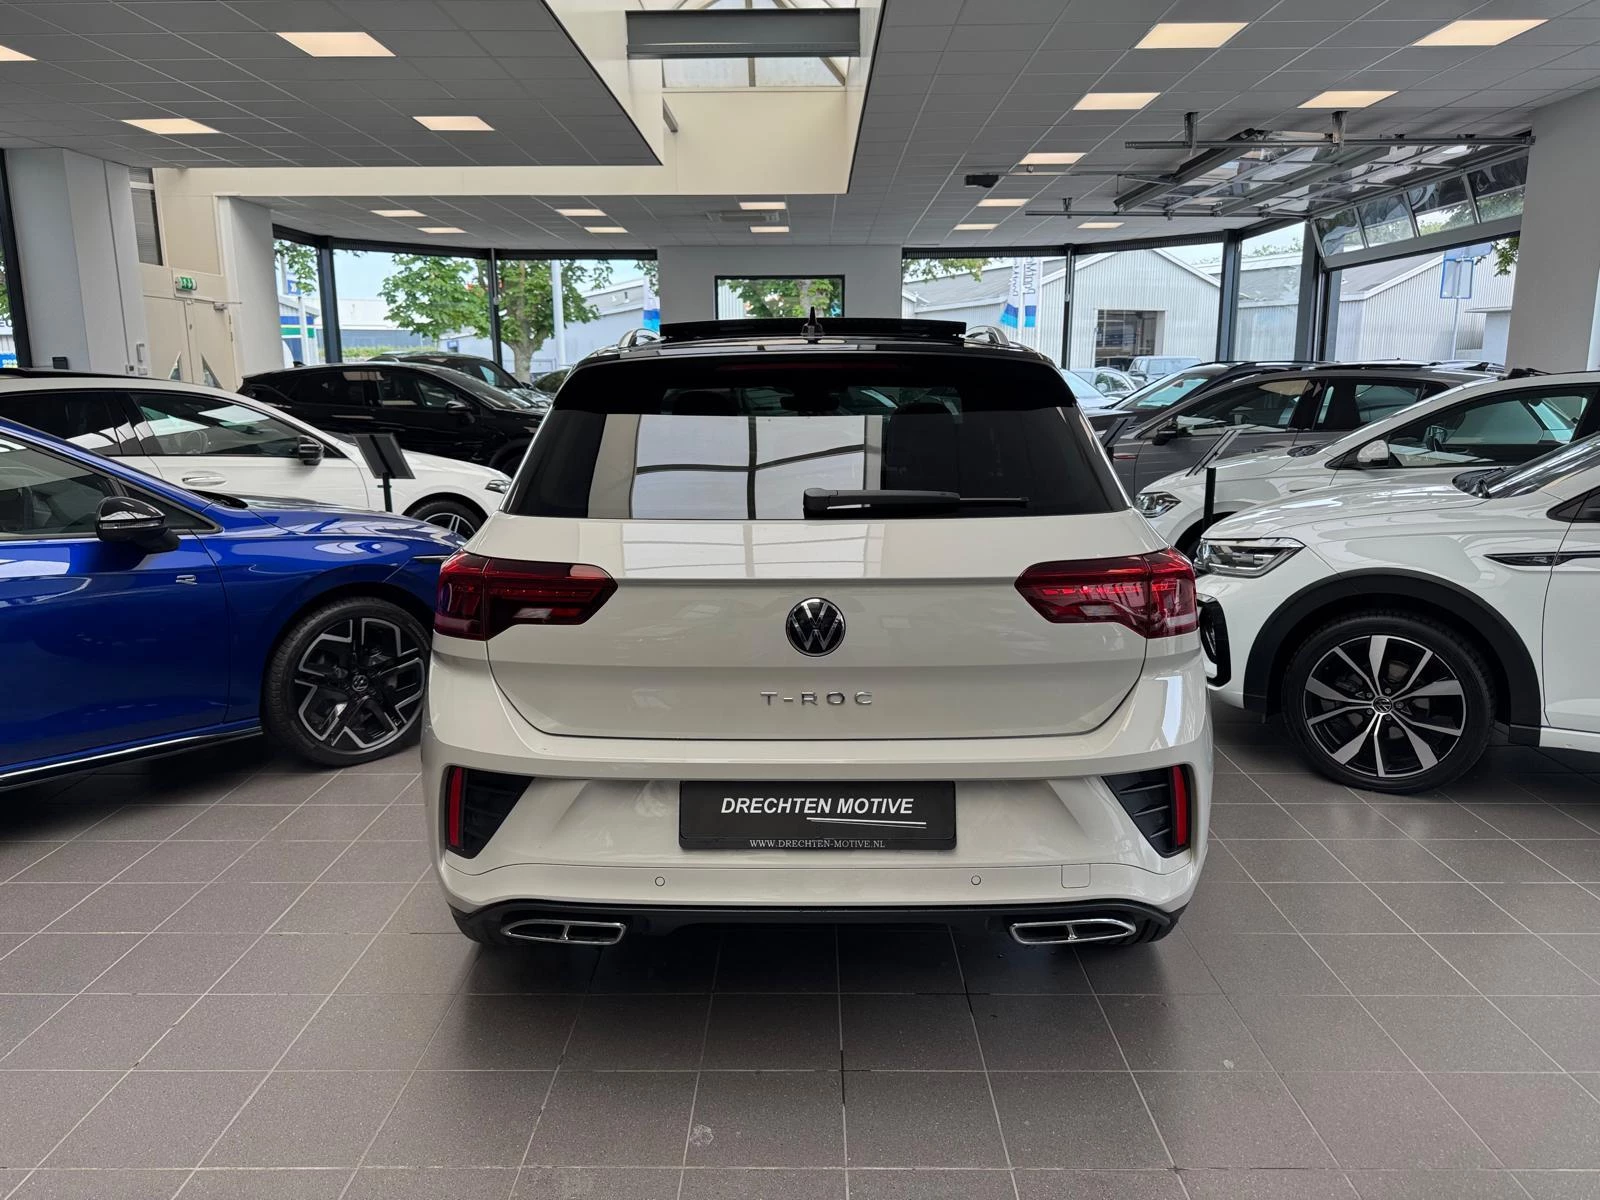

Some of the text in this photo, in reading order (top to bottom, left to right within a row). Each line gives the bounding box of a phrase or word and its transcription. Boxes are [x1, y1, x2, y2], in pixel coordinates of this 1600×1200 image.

[787, 598, 845, 655] VW
[760, 691, 873, 705] T-ROC
[720, 797, 915, 814] DRECHTEN MOTIVE
[749, 839, 886, 849] WWW.DRECHTEN-MOTIVE.NL
